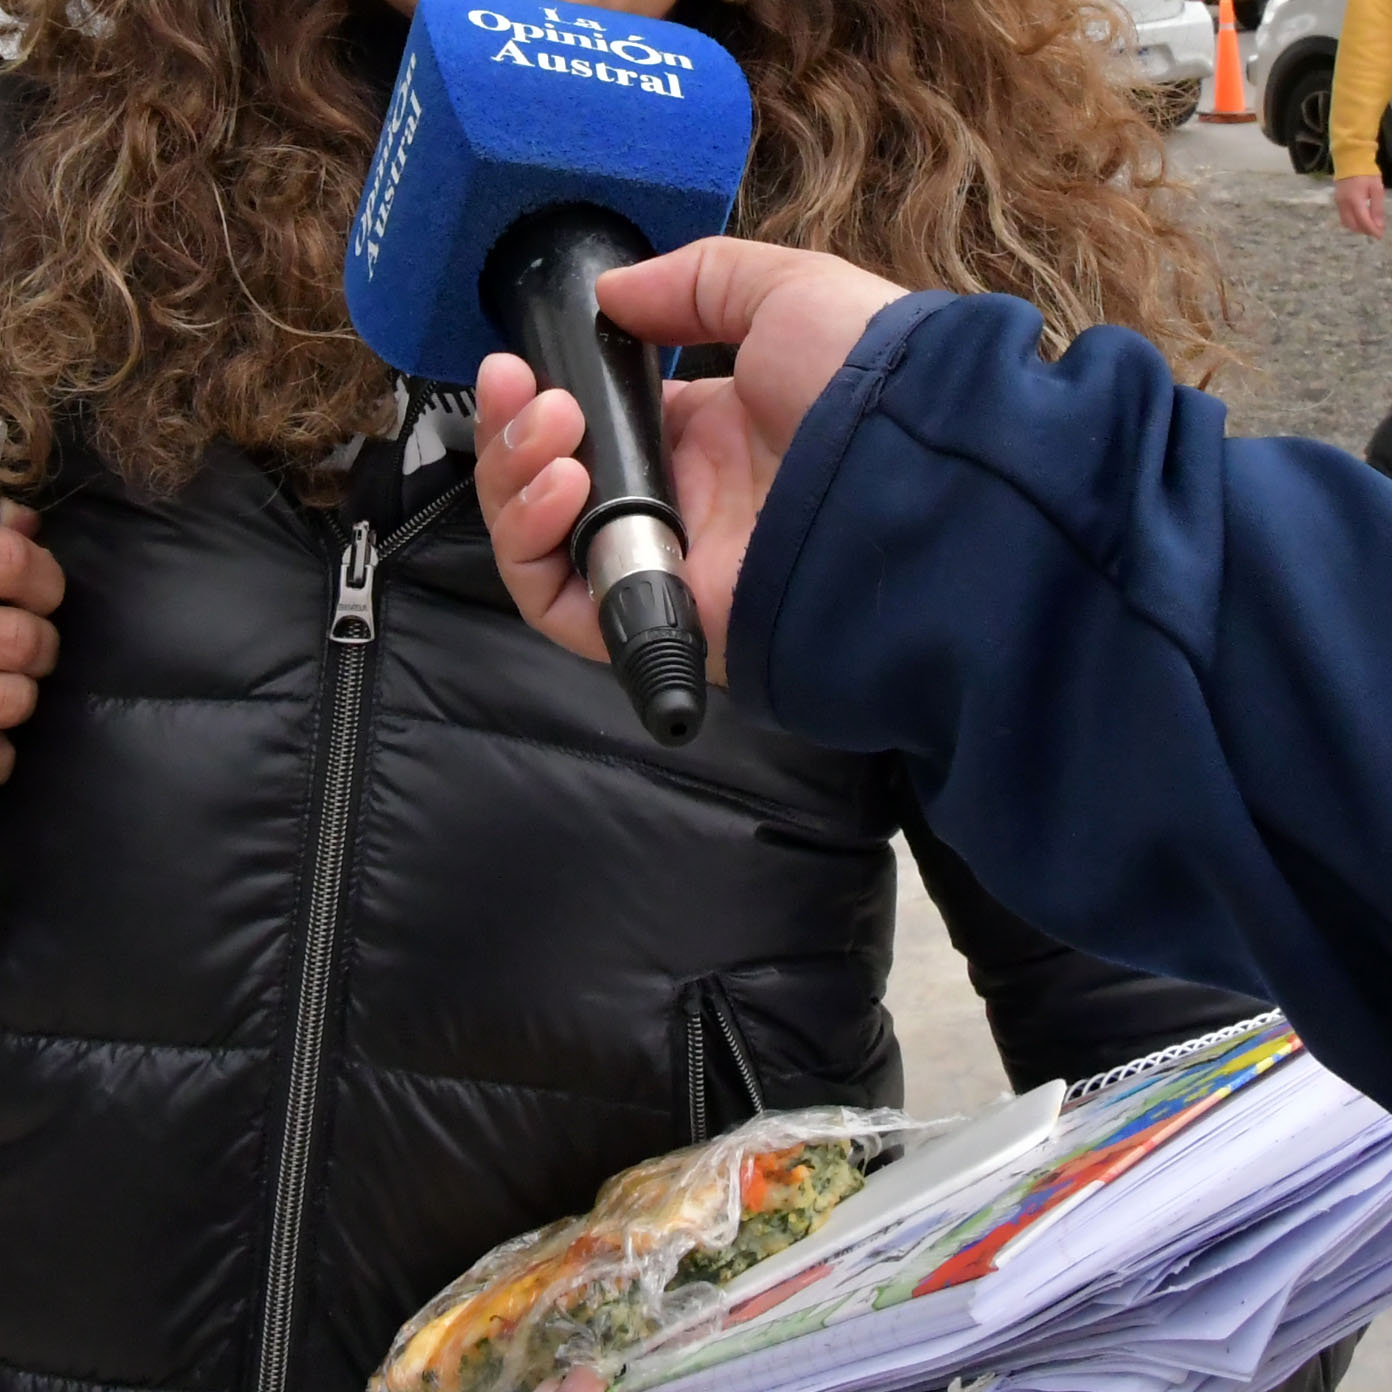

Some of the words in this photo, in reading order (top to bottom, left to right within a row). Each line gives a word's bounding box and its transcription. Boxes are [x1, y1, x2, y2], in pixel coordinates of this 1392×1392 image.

[539, 6, 607, 33] La
[490, 39, 685, 100] Austral
[367, 89, 422, 283] Austral
